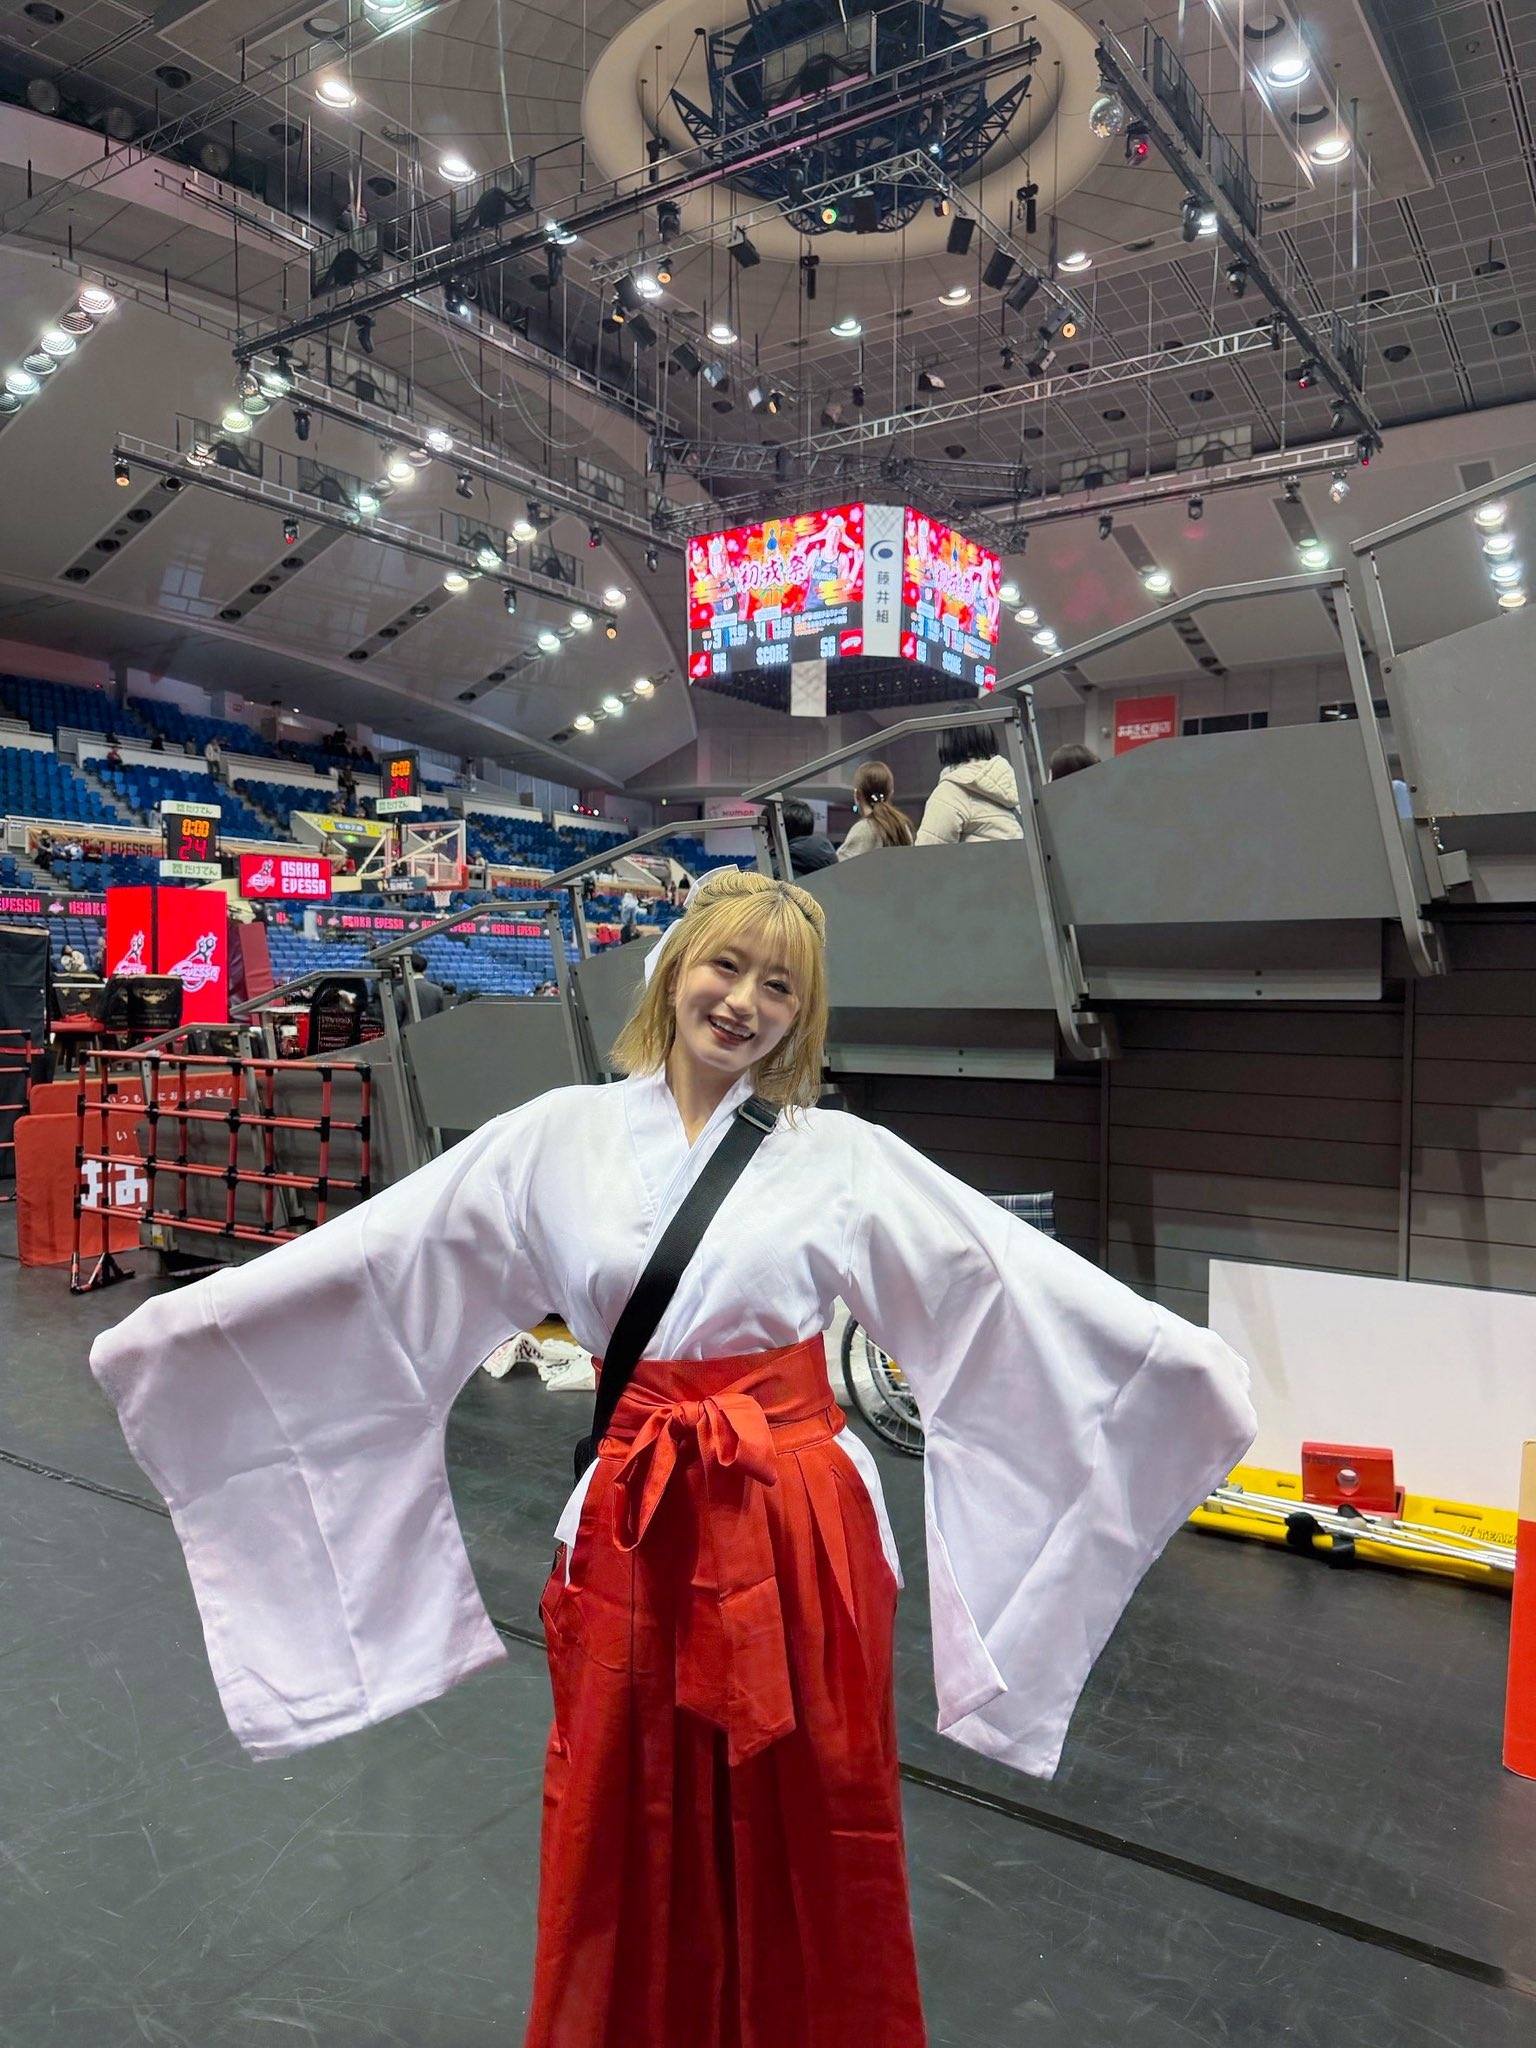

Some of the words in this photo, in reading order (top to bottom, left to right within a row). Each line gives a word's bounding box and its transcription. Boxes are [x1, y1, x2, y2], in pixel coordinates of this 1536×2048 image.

[876, 570, 890, 624] 藤井組
[756, 644, 789, 666] SCORE
[182, 819, 209, 837] 0:00
[178, 836, 208, 861] 24
[281, 861, 319, 878] OSAKA
[281, 878, 327, 895] EVESSA
[374, 917, 404, 930] EVESSA
